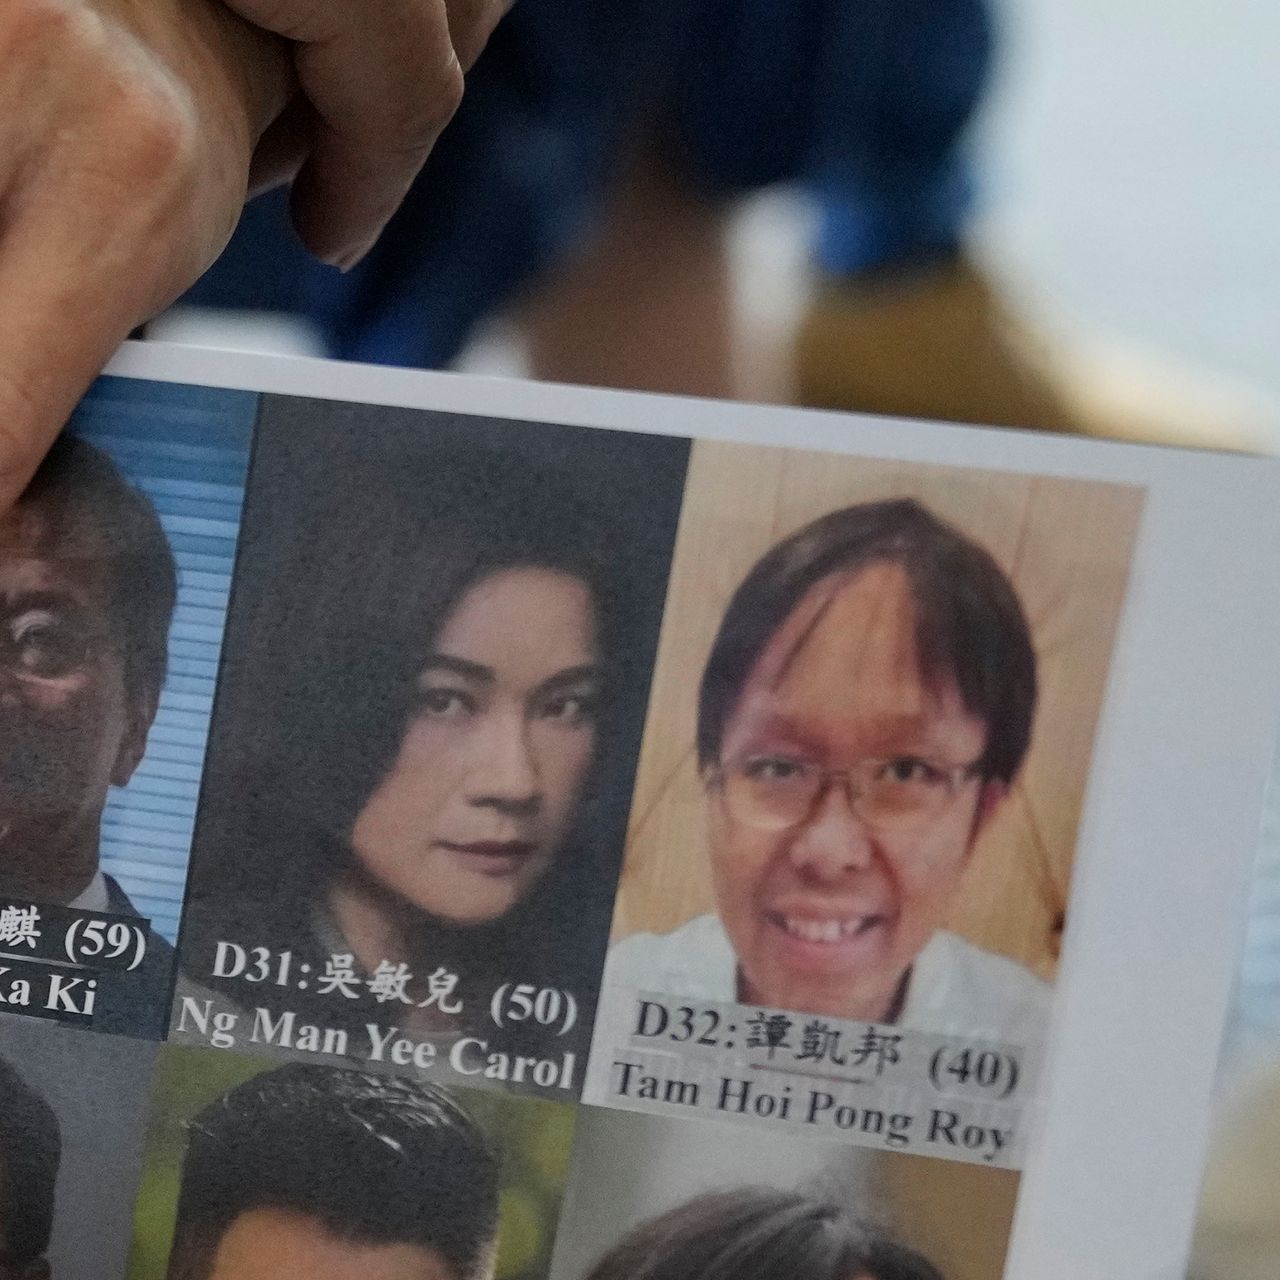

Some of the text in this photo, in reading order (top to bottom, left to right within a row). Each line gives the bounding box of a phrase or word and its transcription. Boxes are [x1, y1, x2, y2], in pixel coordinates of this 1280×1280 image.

[64, 917, 147, 971] (59)
[45, 974, 97, 1014] Ki
[490, 983, 578, 1037] (50)
[176, 998, 575, 1088] Ng Man Yee Carol
[636, 1002, 1021, 1096] D32:譚凱邦 (40)
[612, 1062, 1012, 1160] Tam Hoi Pong Roy
